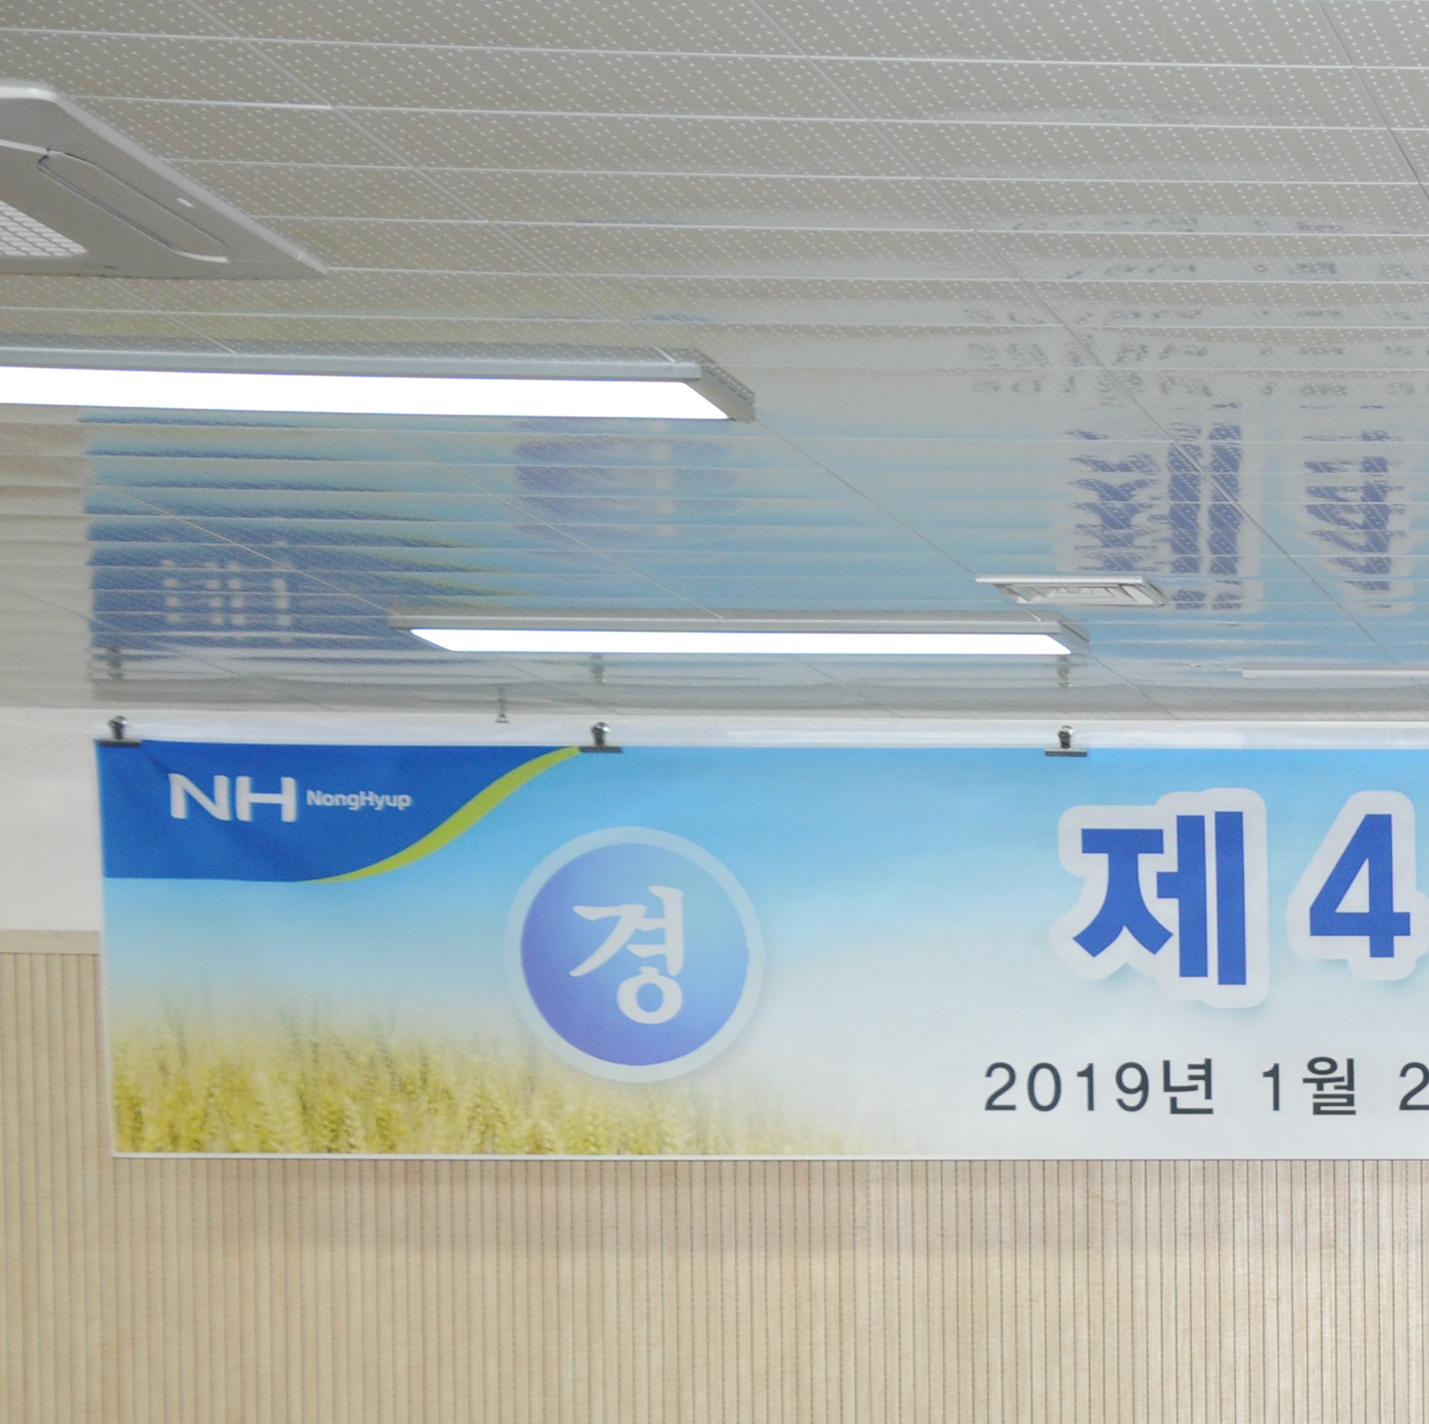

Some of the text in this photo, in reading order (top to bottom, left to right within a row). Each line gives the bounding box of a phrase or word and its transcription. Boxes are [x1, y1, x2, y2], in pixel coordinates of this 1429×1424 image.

[168, 773, 412, 823] NH NongHyup
[570, 885, 685, 1024] 경
[985, 1058, 1214, 1115] 2019년
[1262, 1056, 1358, 1116] 1월
